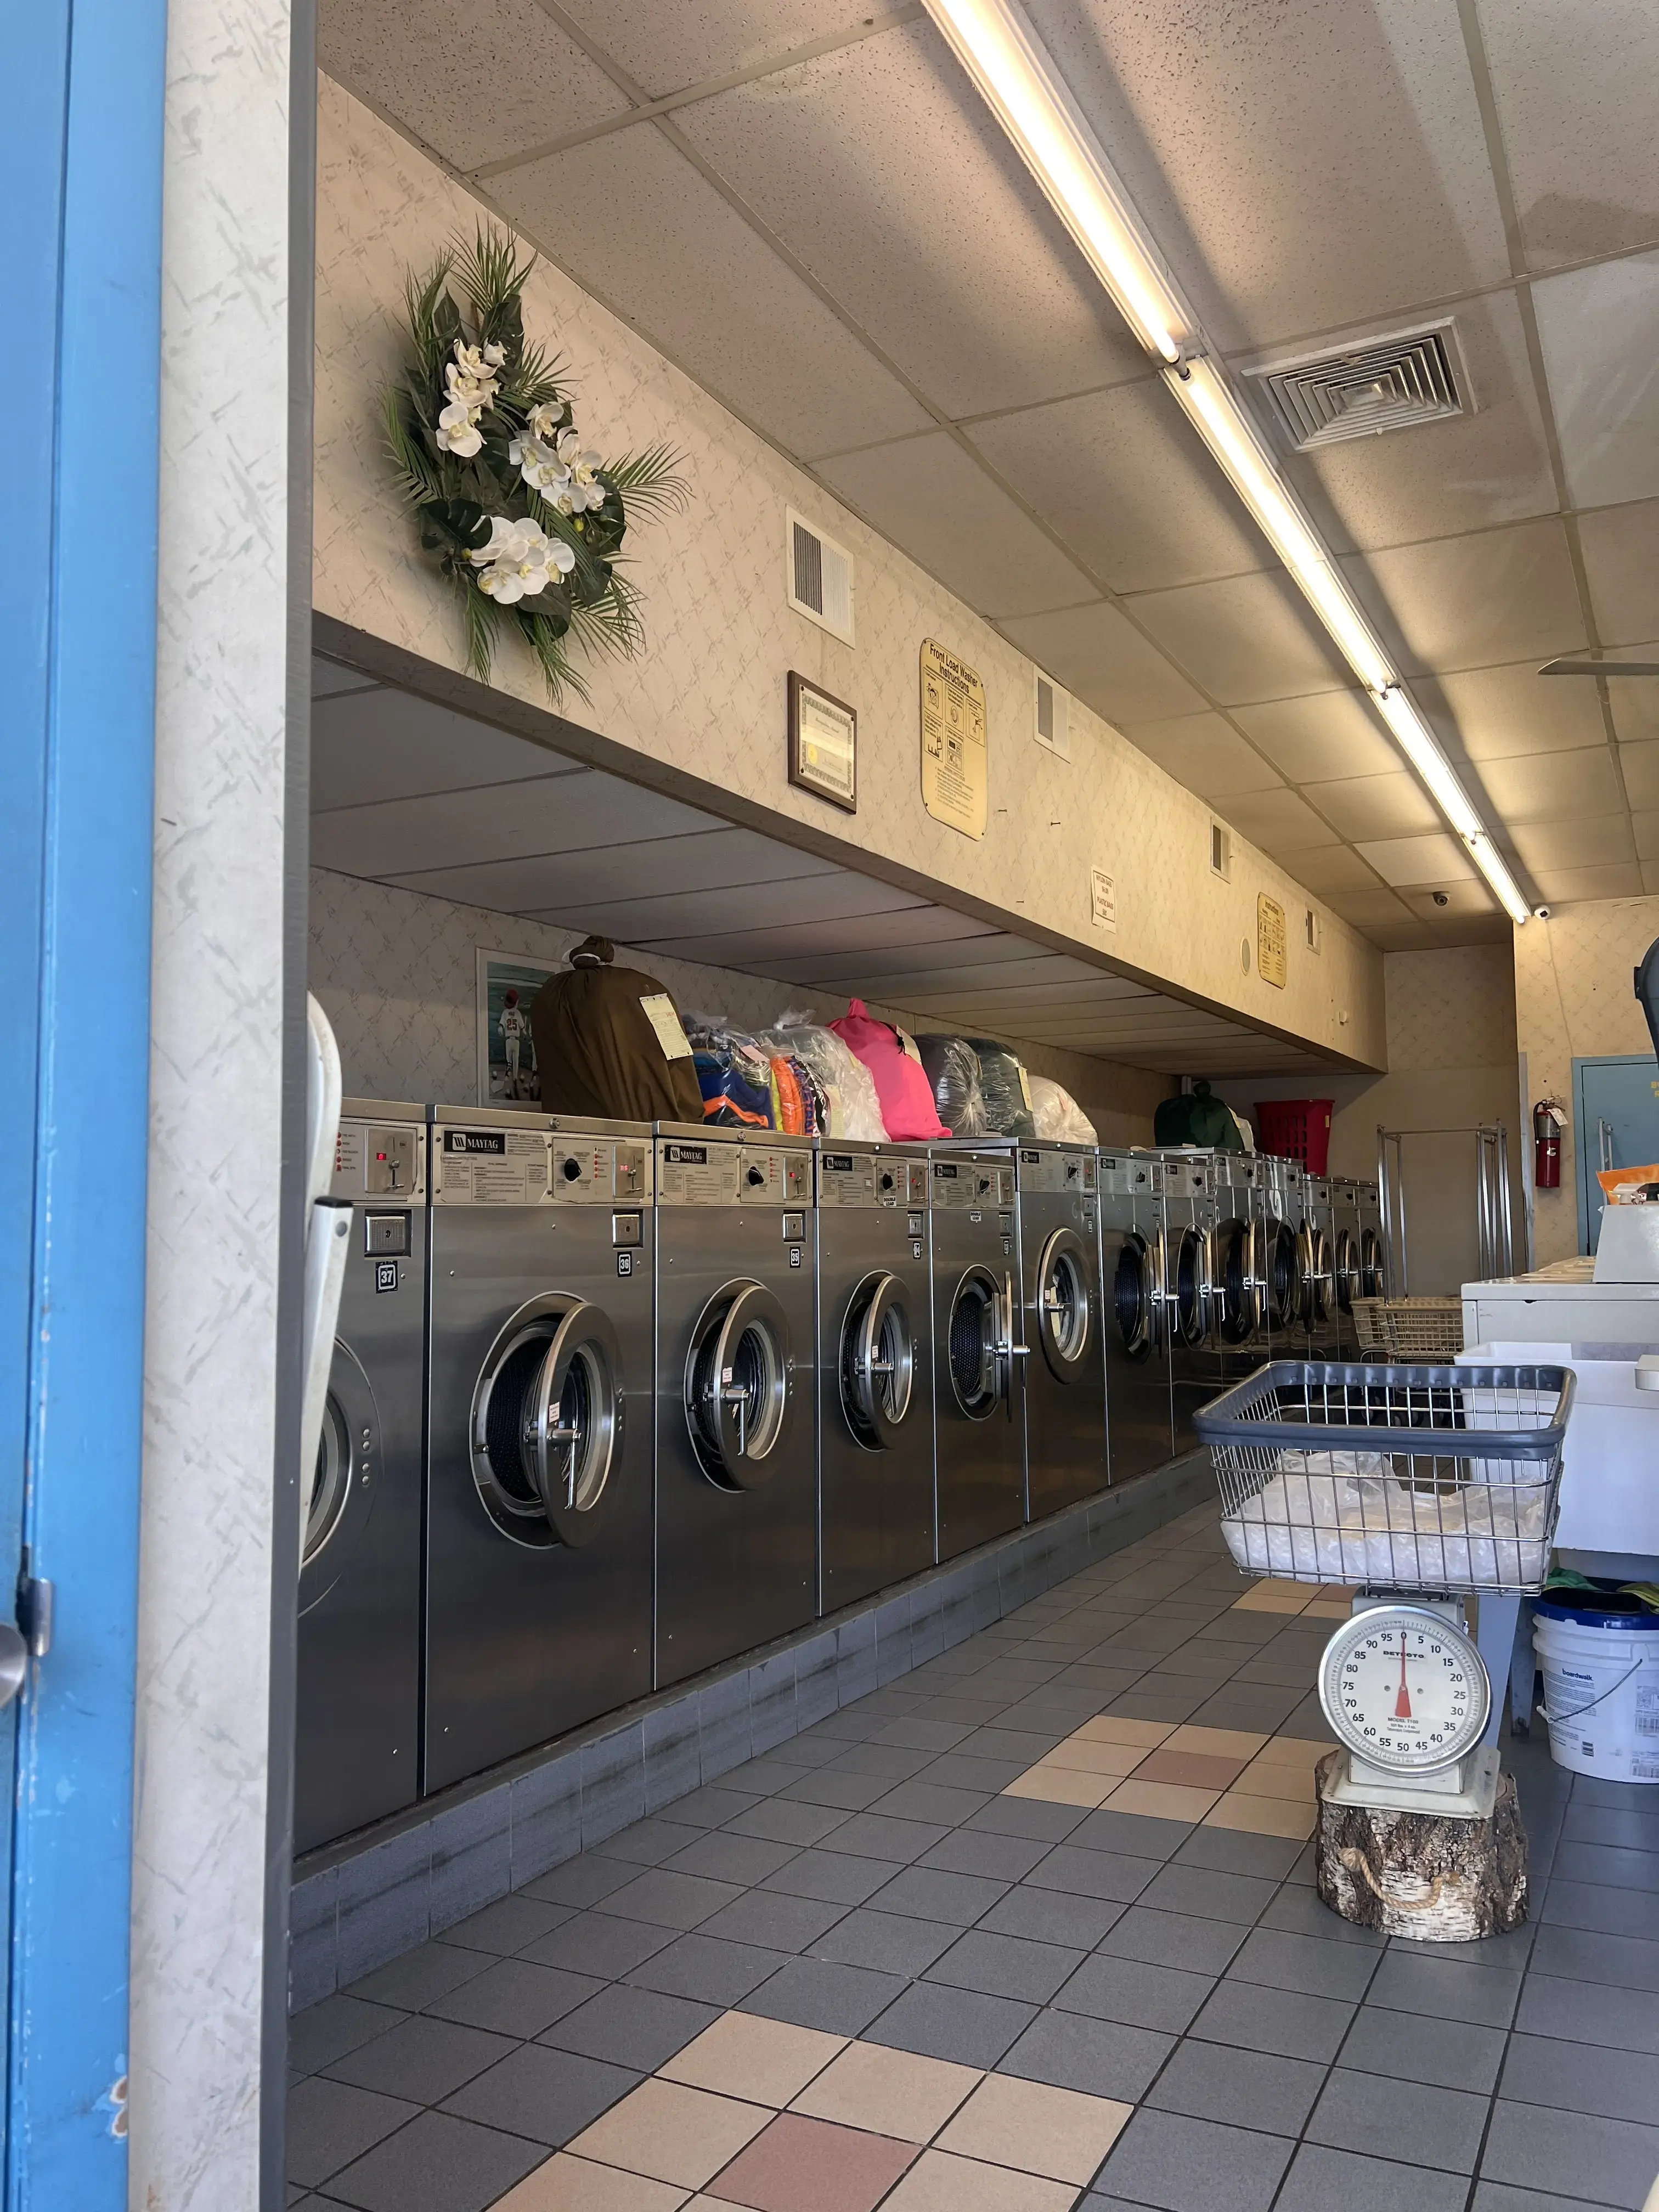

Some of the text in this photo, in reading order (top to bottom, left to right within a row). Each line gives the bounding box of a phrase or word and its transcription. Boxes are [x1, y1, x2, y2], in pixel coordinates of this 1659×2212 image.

[930, 643, 945, 663] Front
[946, 654, 959, 674] Load
[960, 665, 978, 688] Washer
[939, 662, 969, 694] Instructions
[506, 1018, 517, 1031] 25
[467, 1138, 499, 1149] MAYTAG
[680, 1150, 702, 1160] MAYTAG
[792, 1252, 798, 1262] 35
[620, 1259, 629, 1269] 36
[381, 1270, 393, 1283] 37
[1381, 1633, 1392, 1641] 95
[1401, 1632, 1407, 1640] 0
[1418, 1635, 1424, 1644] 5
[1366, 1640, 1378, 1649] 90
[1383, 1650, 1424, 1658] DETECTO
[1431, 1645, 1441, 1654] 10
[1355, 1651, 1366, 1660] 85
[1443, 1658, 1453, 1667] 15
[1346, 1664, 1358, 1673] 80
[1450, 1673, 1463, 1682] 20
[1342, 1681, 1354, 1690] 75
[1454, 1690, 1466, 1699] 25
[1345, 1699, 1357, 1707] 70
[1451, 1707, 1463, 1716] 30
[1352, 1713, 1364, 1722] 65
[1443, 1722, 1455, 1730] 35
[1363, 1728, 1376, 1736] 60
[1379, 1737, 1391, 1746] 55
[1430, 1734, 1442, 1742] 40
[1397, 1743, 1409, 1752] 50
[1415, 1741, 1428, 1750] 45
